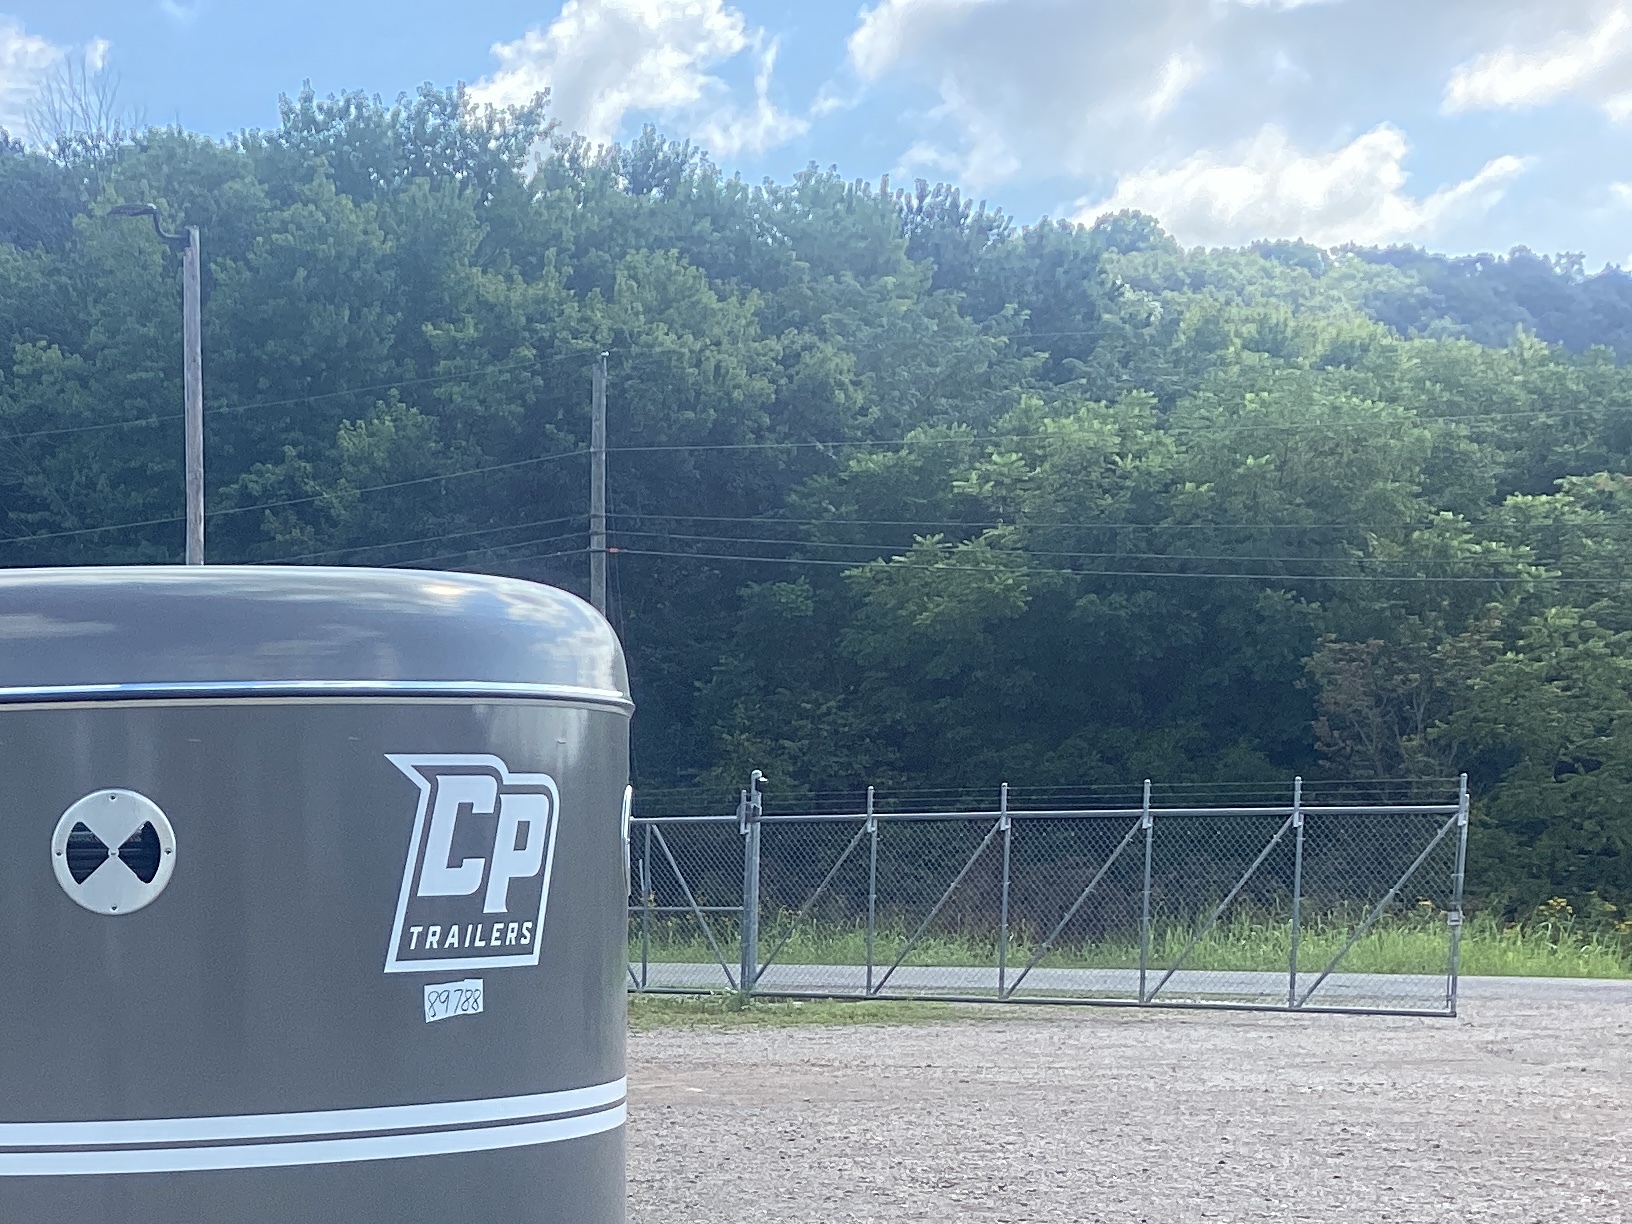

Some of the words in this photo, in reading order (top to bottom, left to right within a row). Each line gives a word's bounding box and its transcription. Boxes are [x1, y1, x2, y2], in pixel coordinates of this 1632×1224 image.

[417, 774, 549, 914] CP
[408, 921, 533, 950] TRAILERS
[427, 988, 482, 1019] 89788
